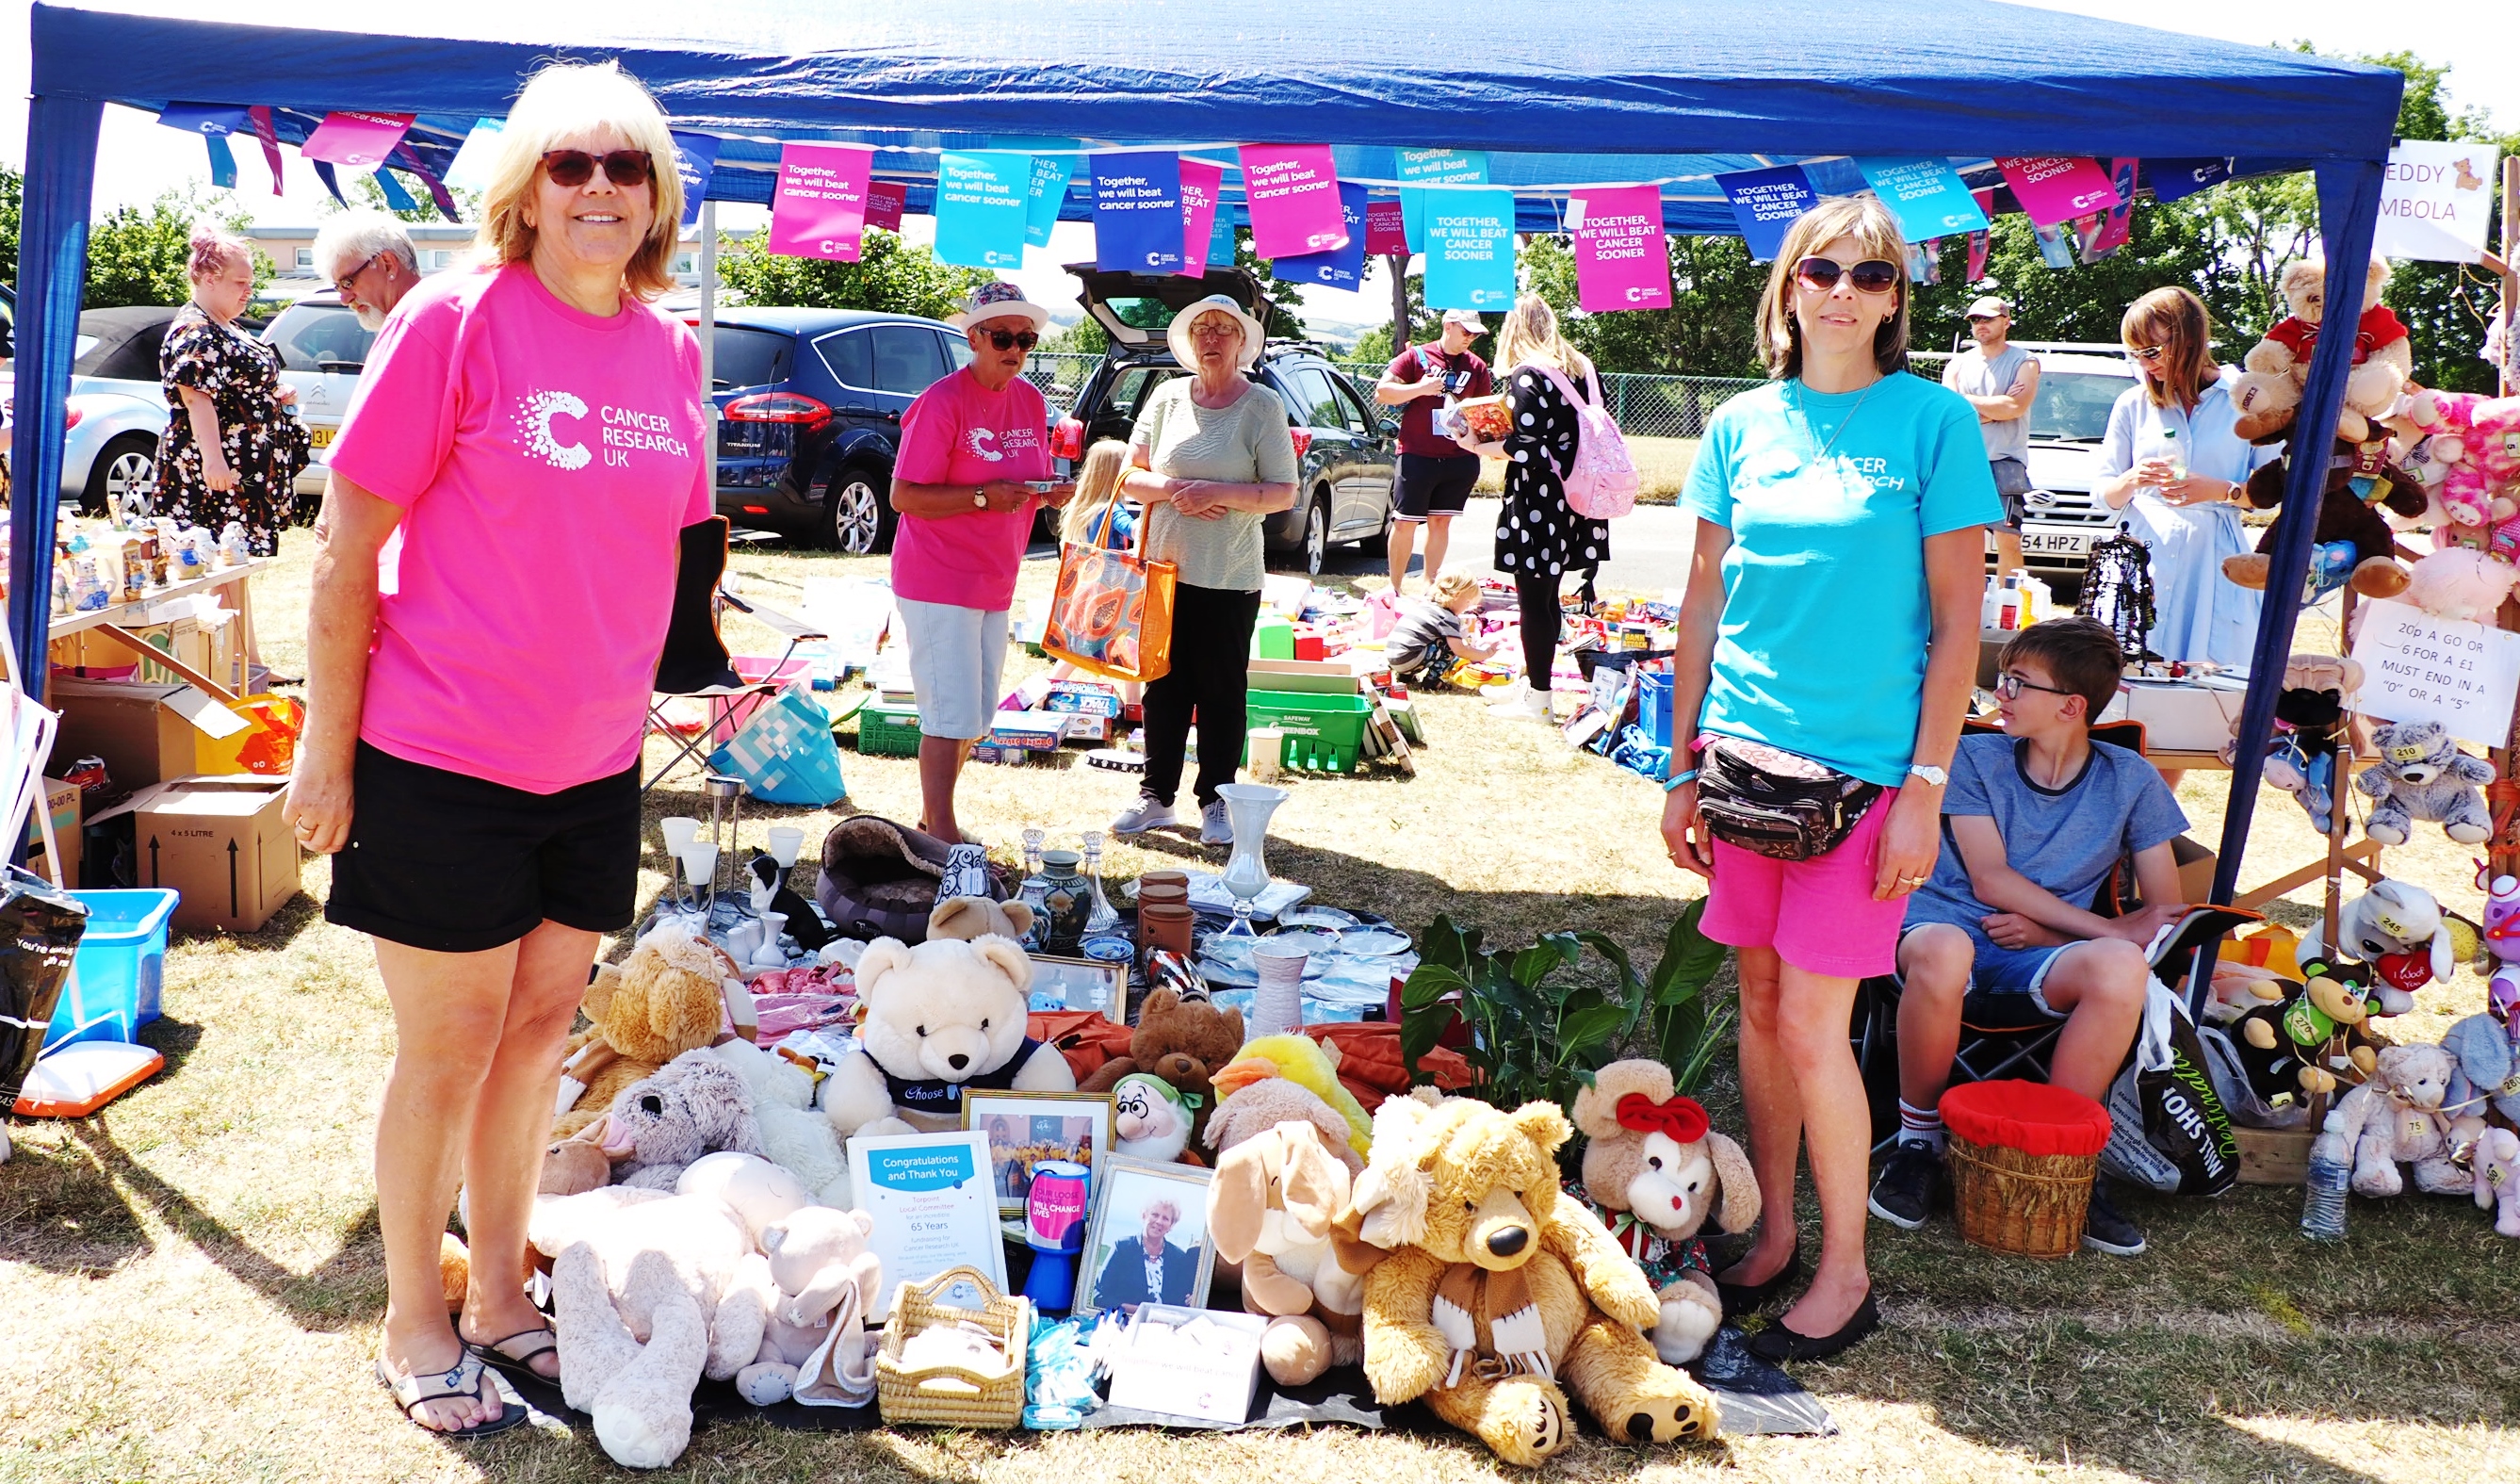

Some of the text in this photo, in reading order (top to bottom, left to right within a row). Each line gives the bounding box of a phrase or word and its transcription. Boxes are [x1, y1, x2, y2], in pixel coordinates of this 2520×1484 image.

[370, 115, 405, 128] sooner
[1402, 149, 1454, 163] Together,
[1031, 156, 1058, 172] THER,
[1249, 160, 1300, 176] Together,
[1405, 158, 1468, 175] we will beat
[1875, 160, 1937, 178] TOGETHER,
[2003, 158, 2020, 170] WE
[788, 164, 837, 179] Together,
[947, 167, 997, 181] Together,
[1036, 169, 1065, 182] BEAT
[1270, 173, 1289, 185] will
[1291, 170, 1315, 181] beat
[1444, 171, 1480, 184] sooner
[1874, 167, 1947, 188] WE WILL BEAT
[2026, 163, 2075, 185] SOONER
[2386, 164, 2446, 183] EDDY
[677, 173, 703, 185] oner
[786, 176, 850, 190] we will beat
[1097, 175, 1148, 188] Together,
[1894, 177, 1940, 192] CANCER
[946, 180, 1010, 194] we will beat
[1098, 188, 1162, 198] we will beat
[1253, 179, 1330, 200] cancer sooner
[1736, 183, 1799, 195] TOGETHER,
[1898, 186, 1946, 202] SOONER
[784, 188, 861, 203] cancer sooner
[944, 192, 1021, 207] cancer sooner
[1182, 195, 1210, 208] BEAT
[1733, 190, 1808, 205] WE WILL BEAT
[1099, 200, 1176, 210] cancer sooner
[1752, 200, 1798, 212] CANCER
[2378, 198, 2456, 220] MBOLA
[1342, 216, 1359, 224] EAT
[1585, 215, 1649, 228] TOGETHER,
[1756, 209, 1803, 221] SOONER
[1437, 217, 1501, 228] TOGETHER,
[1430, 228, 1508, 237] WE WILL BEAT
[1579, 225, 1656, 239] WE WILL BEAT
[1445, 239, 1492, 250] CANCER
[1596, 237, 1643, 250] CANCER
[1444, 251, 1493, 260] SOONER
[1596, 249, 1645, 260] SOONER
[600, 405, 671, 433] CANCER
[313, 430, 322, 444] 13
[1000, 428, 1034, 440] CANCER
[603, 427, 690, 458] RESEARCH
[1003, 438, 1039, 448] RESEARC
[603, 448, 629, 467] UK
[1007, 449, 1019, 458] UK
[2022, 535, 2081, 551] 54 HPZ
[2398, 623, 2483, 653] 20p A GO OR
[2401, 644, 2473, 671] 6 FOR A £1
[2382, 660, 2485, 694] MUST END IN A
[2409, 688, 2428, 700] OR
[2432, 694, 2442, 705] A
[2397, 747, 2415, 756] 210
[66, 792, 75, 802] PL
[2383, 918, 2401, 932] 245
[16, 938, 47, 954] You're
[904, 1085, 944, 1101] Choose
[883, 1155, 959, 1169] Congratulations
[2199, 1133, 2224, 1179] MILL
[887, 1168, 958, 1182] and Thank You
[918, 1203, 954, 1212] Committee
[1032, 1208, 1049, 1219] LIVES
[1033, 1200, 1080, 1214] WILL CHANGE
[911, 1221, 949, 1231] 65 Years
